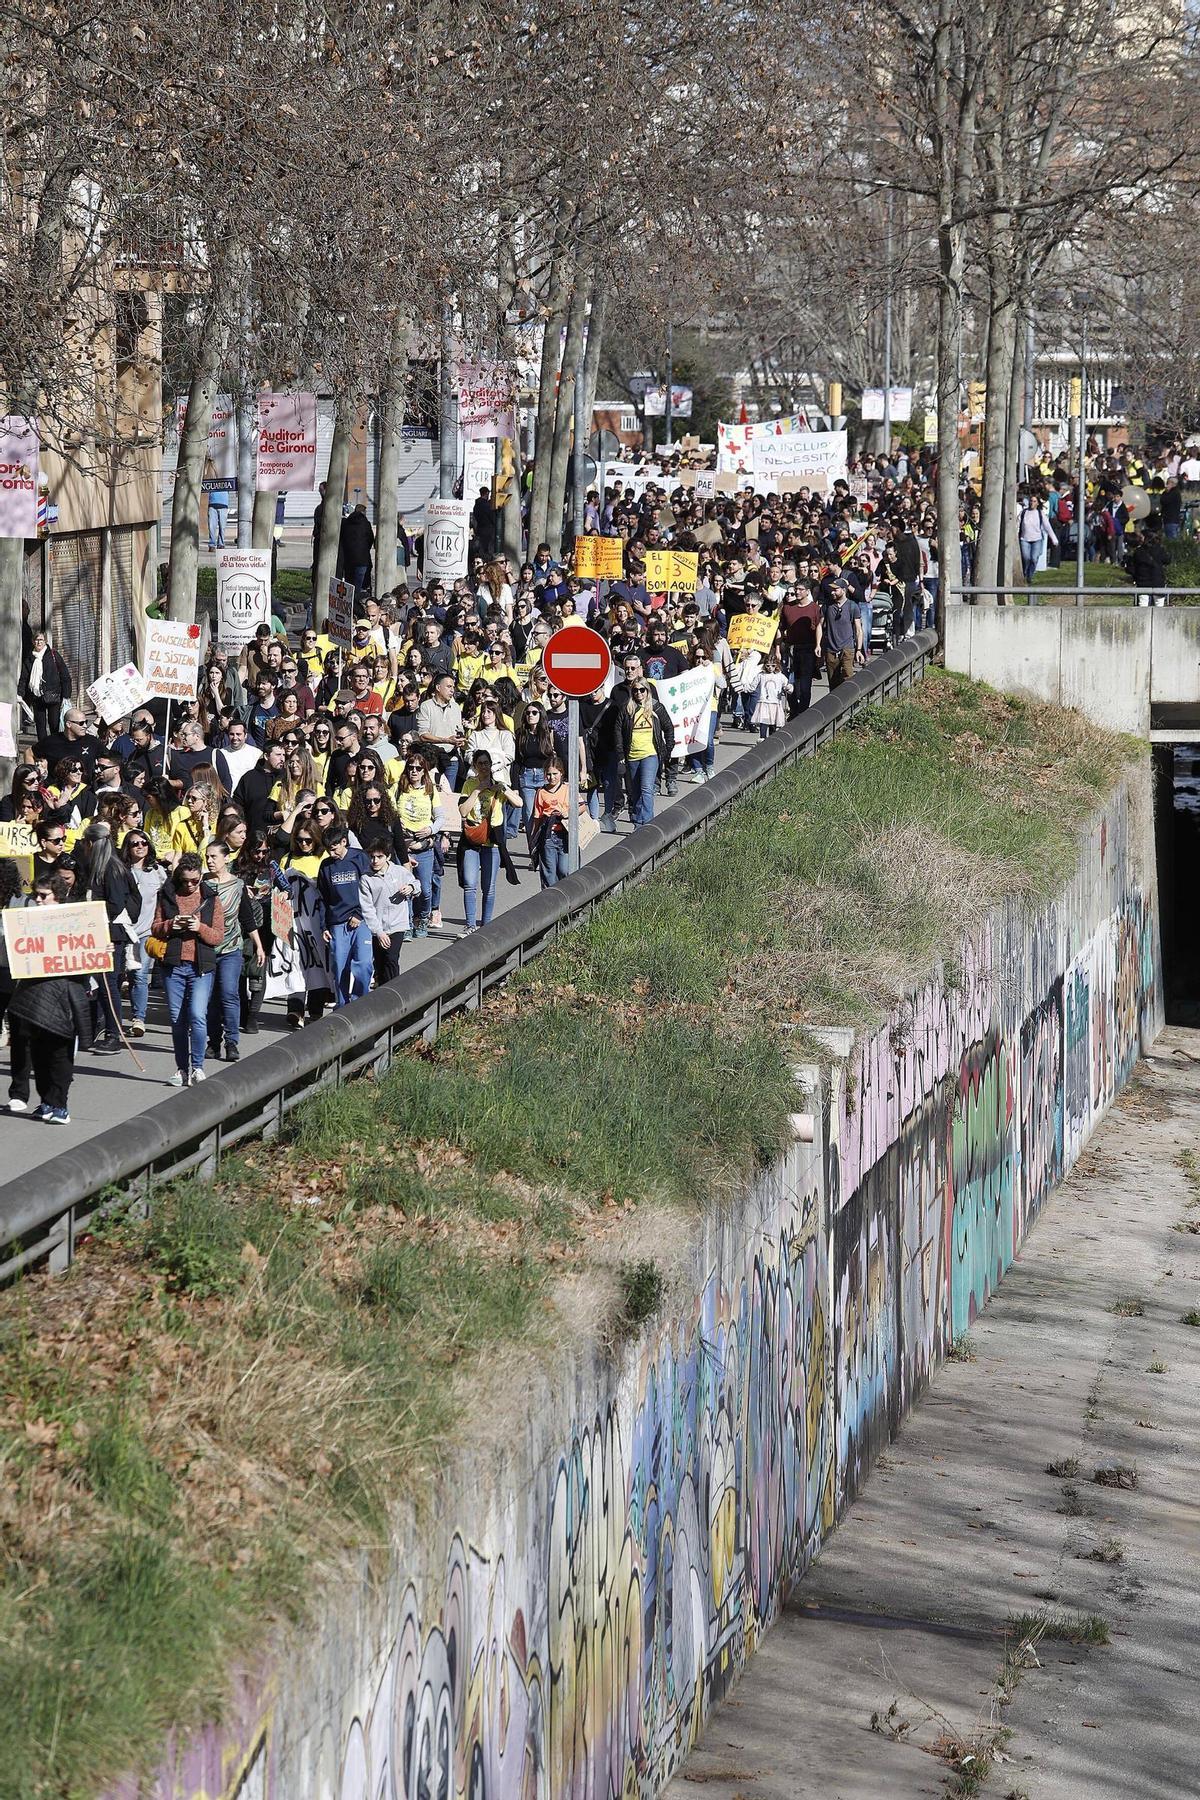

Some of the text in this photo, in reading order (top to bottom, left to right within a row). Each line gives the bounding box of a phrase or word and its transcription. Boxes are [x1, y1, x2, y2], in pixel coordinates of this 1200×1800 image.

[260, 429, 305, 442] Auditori
[260, 441, 315, 453] de Girona
[760, 443, 777, 452] LA
[259, 461, 294, 469] Temporada
[0, 479, 35, 490] ona
[201, 481, 233, 491] NGUARDIA
[697, 480, 712, 490] PAE
[435, 535, 459, 551] CIRC
[652, 552, 663, 561] EL
[648, 580, 667, 590] SOM
[231, 592, 260, 610] CIRC
[149, 650, 160, 661] EL
[151, 665, 179, 679] A LA
[13, 936, 45, 955] CAN
